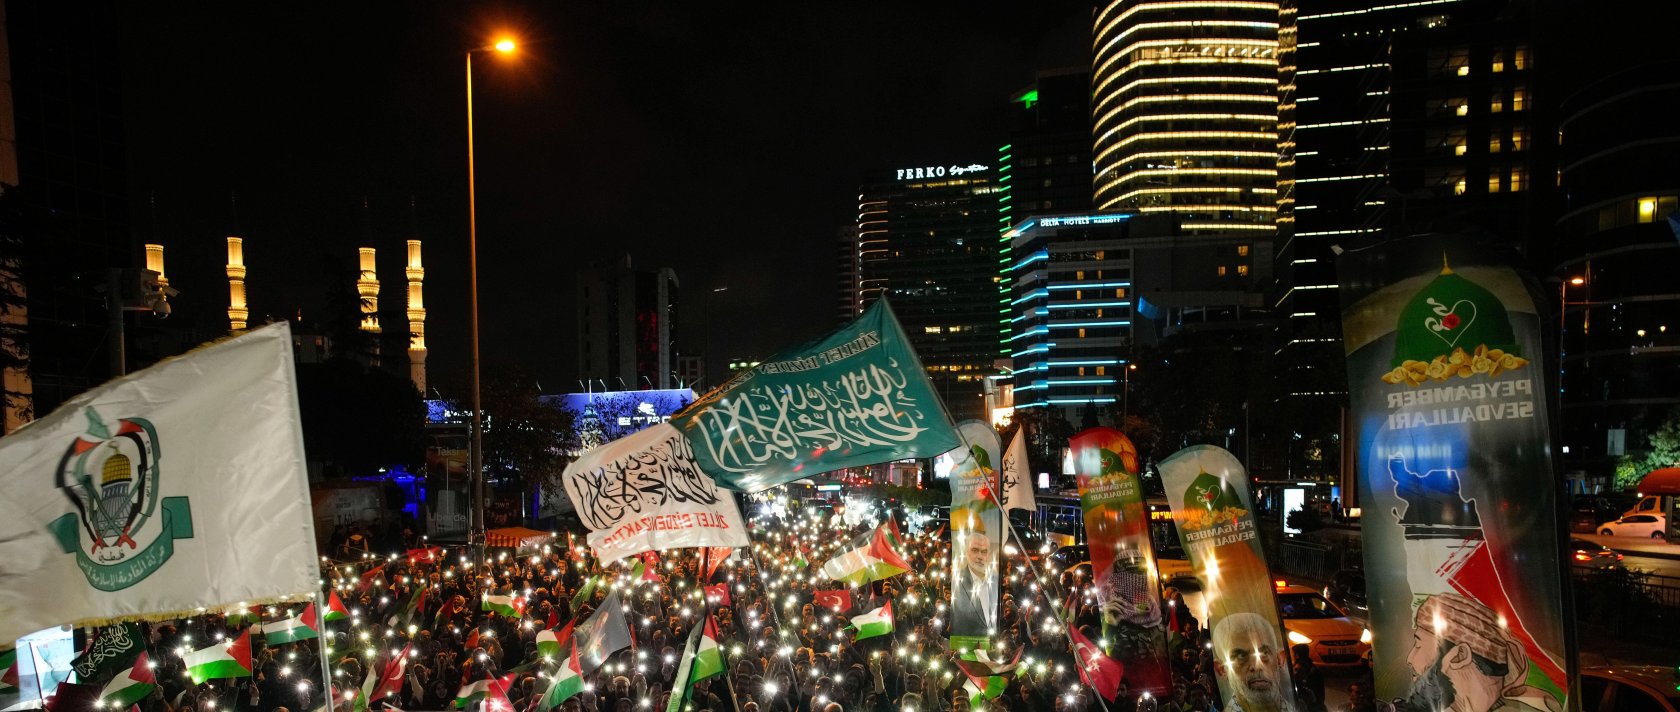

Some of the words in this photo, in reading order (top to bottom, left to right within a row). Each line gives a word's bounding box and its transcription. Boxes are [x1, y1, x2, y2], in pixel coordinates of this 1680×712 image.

[897, 166, 945, 180] FERKO
[1040, 218, 1060, 227] DELTA
[1063, 216, 1090, 225] HOTELS
